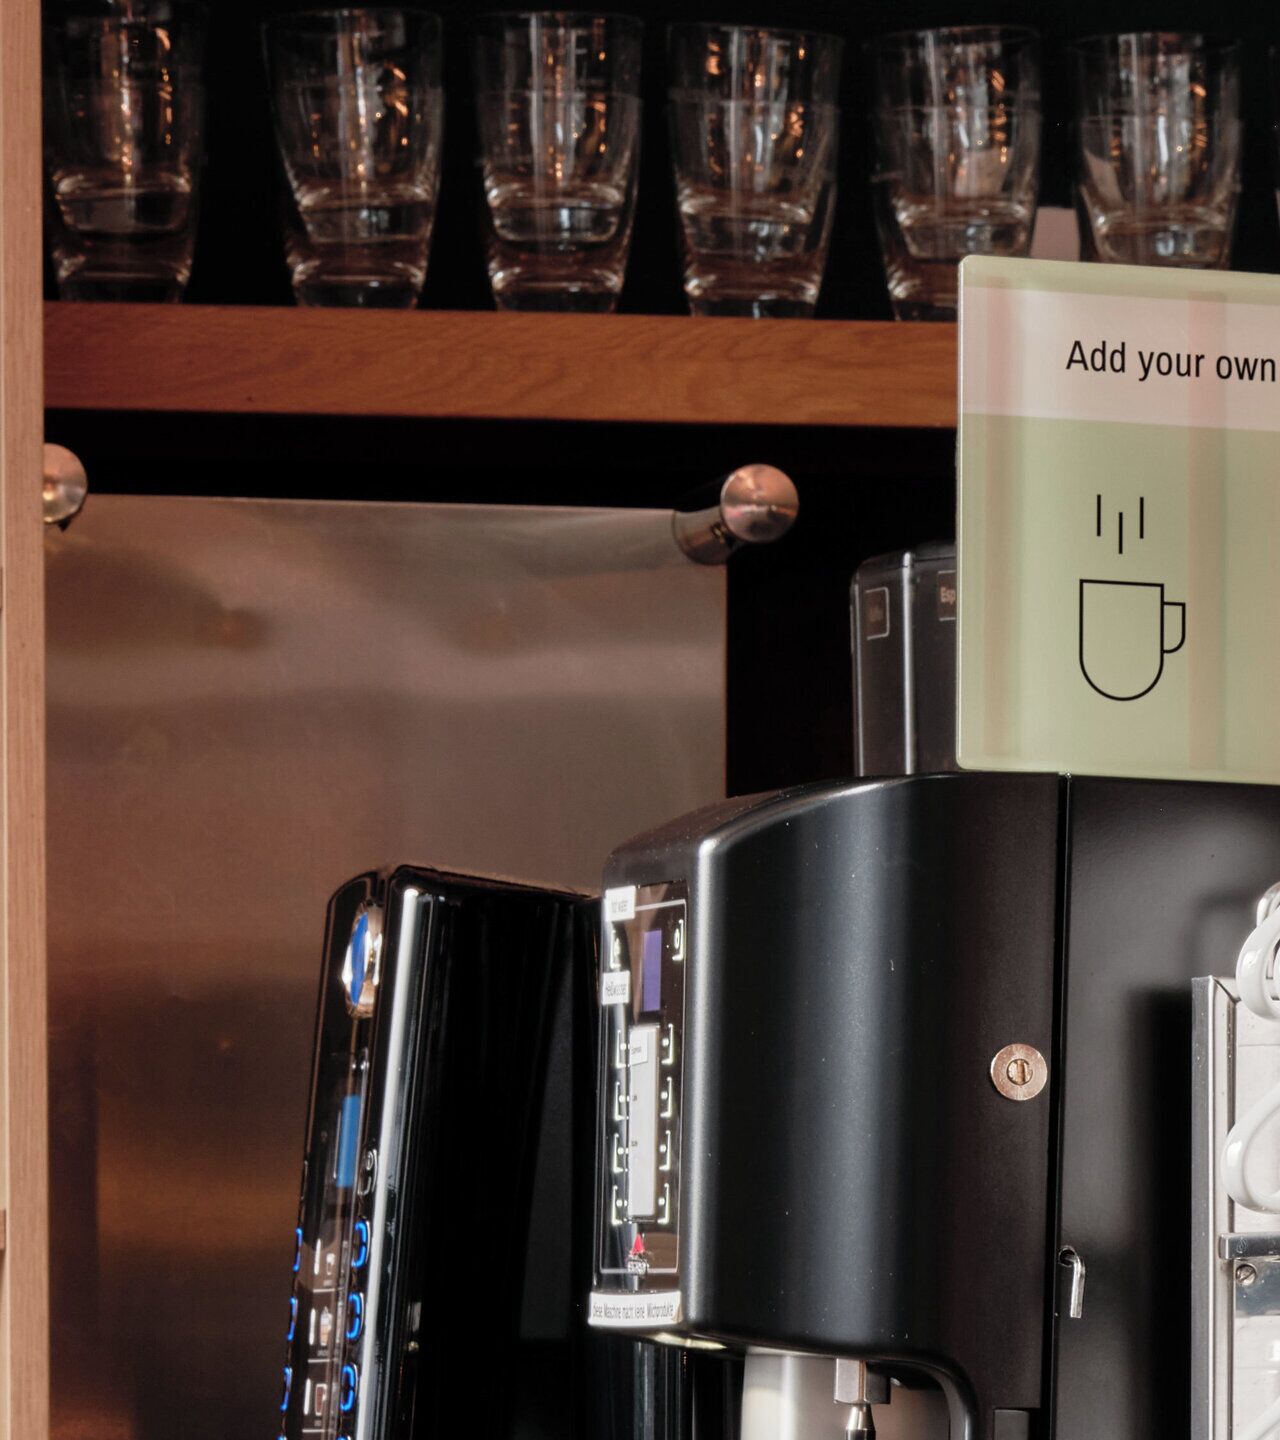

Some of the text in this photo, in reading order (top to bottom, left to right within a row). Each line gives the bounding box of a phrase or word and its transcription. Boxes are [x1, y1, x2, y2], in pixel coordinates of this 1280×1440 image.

[1065, 340, 1276, 383] Add your own
